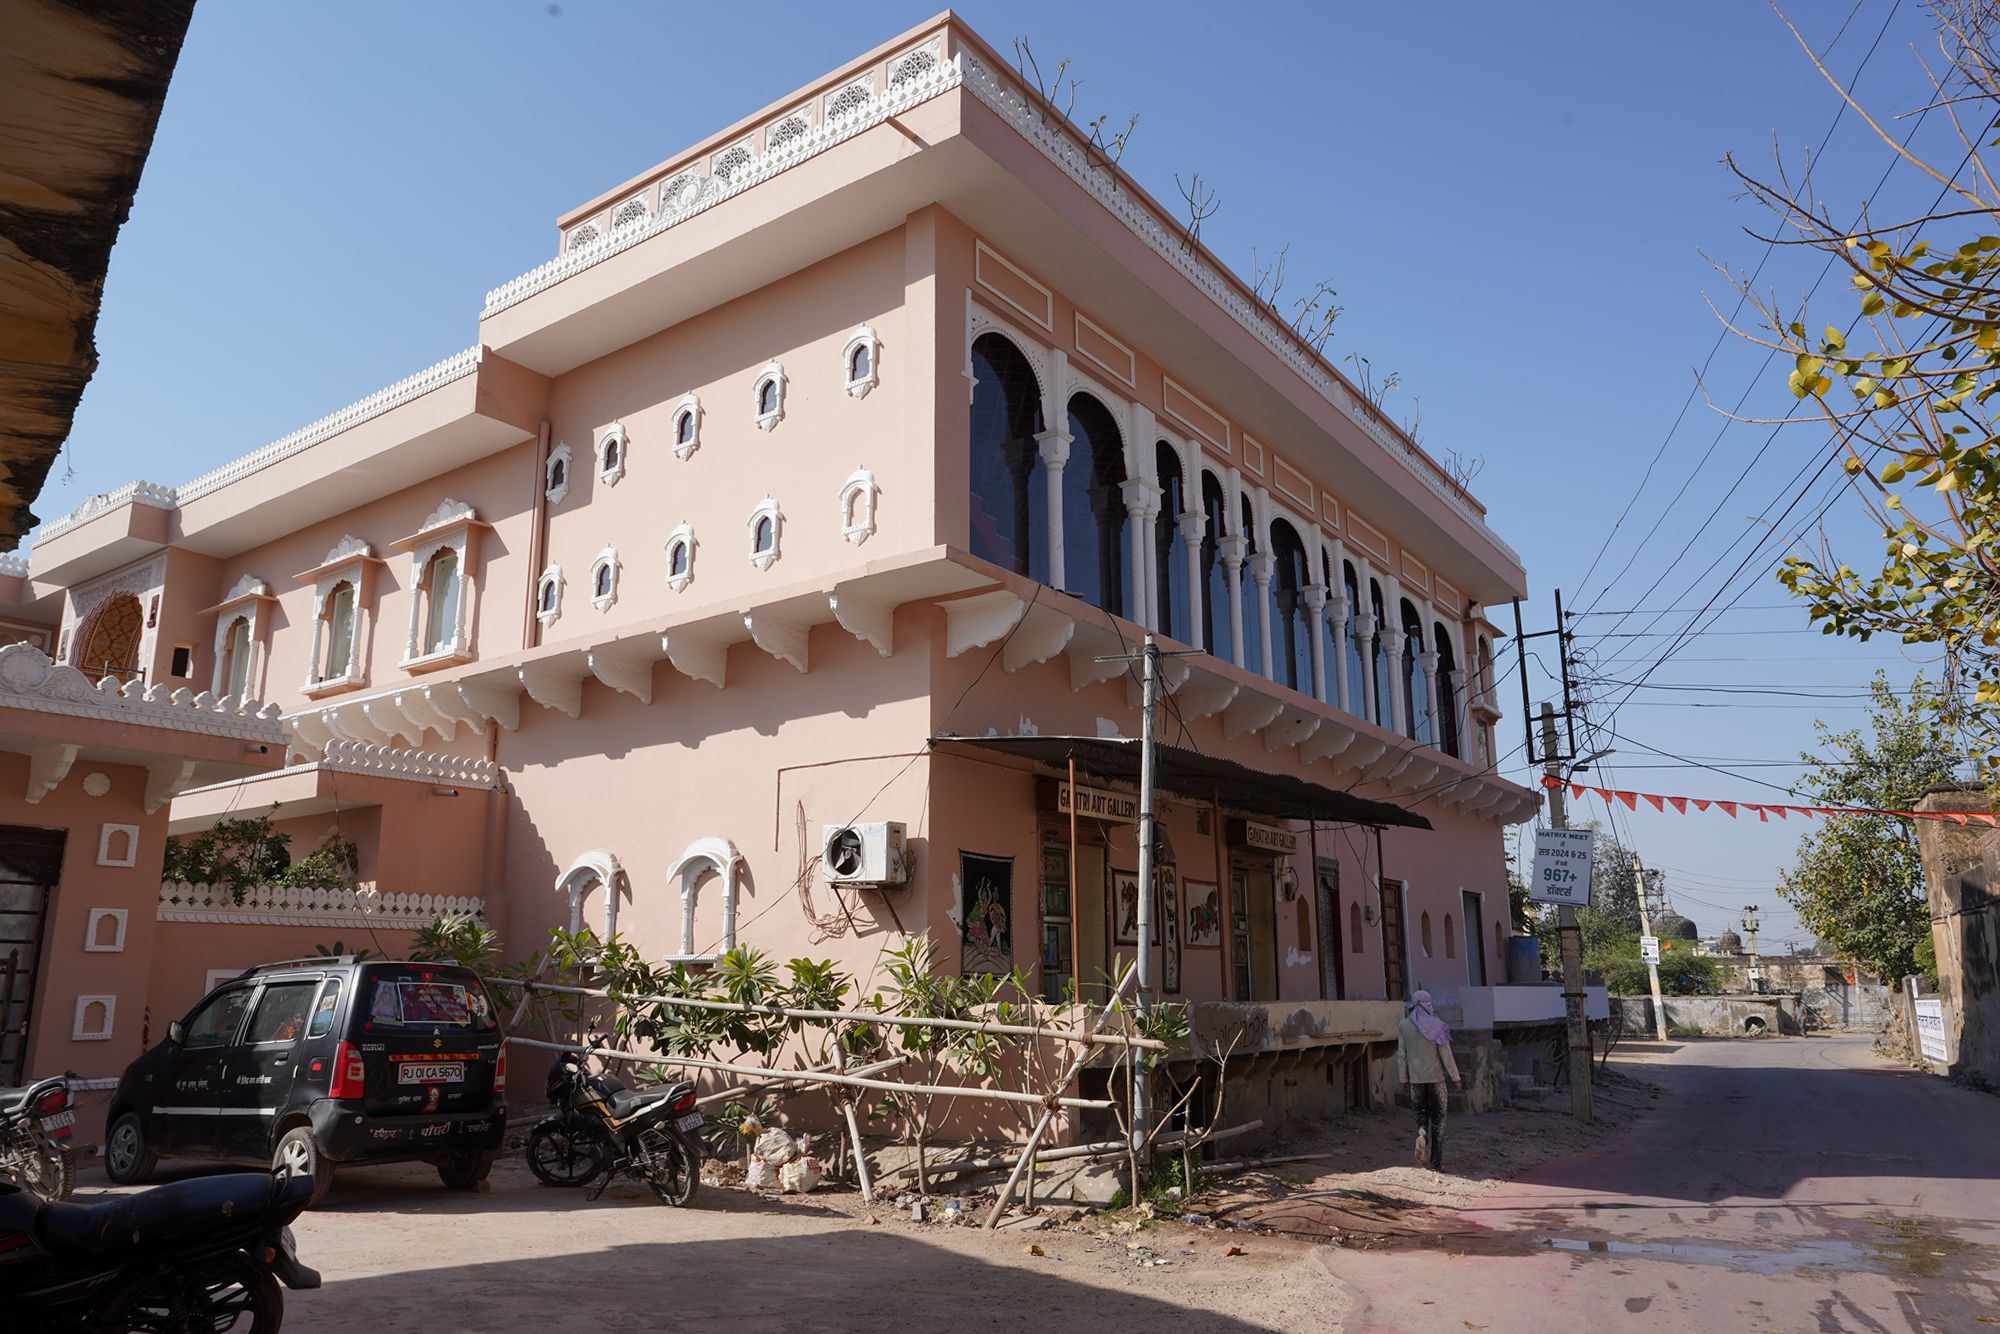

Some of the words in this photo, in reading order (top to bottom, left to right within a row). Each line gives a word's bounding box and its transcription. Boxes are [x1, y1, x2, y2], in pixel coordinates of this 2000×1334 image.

[1091, 795, 1106, 814] ART
[1107, 798, 1136, 818] GALLERY
[1270, 831, 1279, 846] ART
[1538, 831, 1567, 839] MATRIX
[1538, 848, 1550, 856] सत्र
[1551, 849, 1569, 857] 2024
[1578, 852, 1586, 860] 25
[1543, 868, 1577, 882] 967+
[1546, 884, 1573, 896] डॉक्टर्स
[403, 1068, 413, 1079] RJ
[426, 1068, 437, 1078] CA
[439, 1067, 460, 1077] 5670
